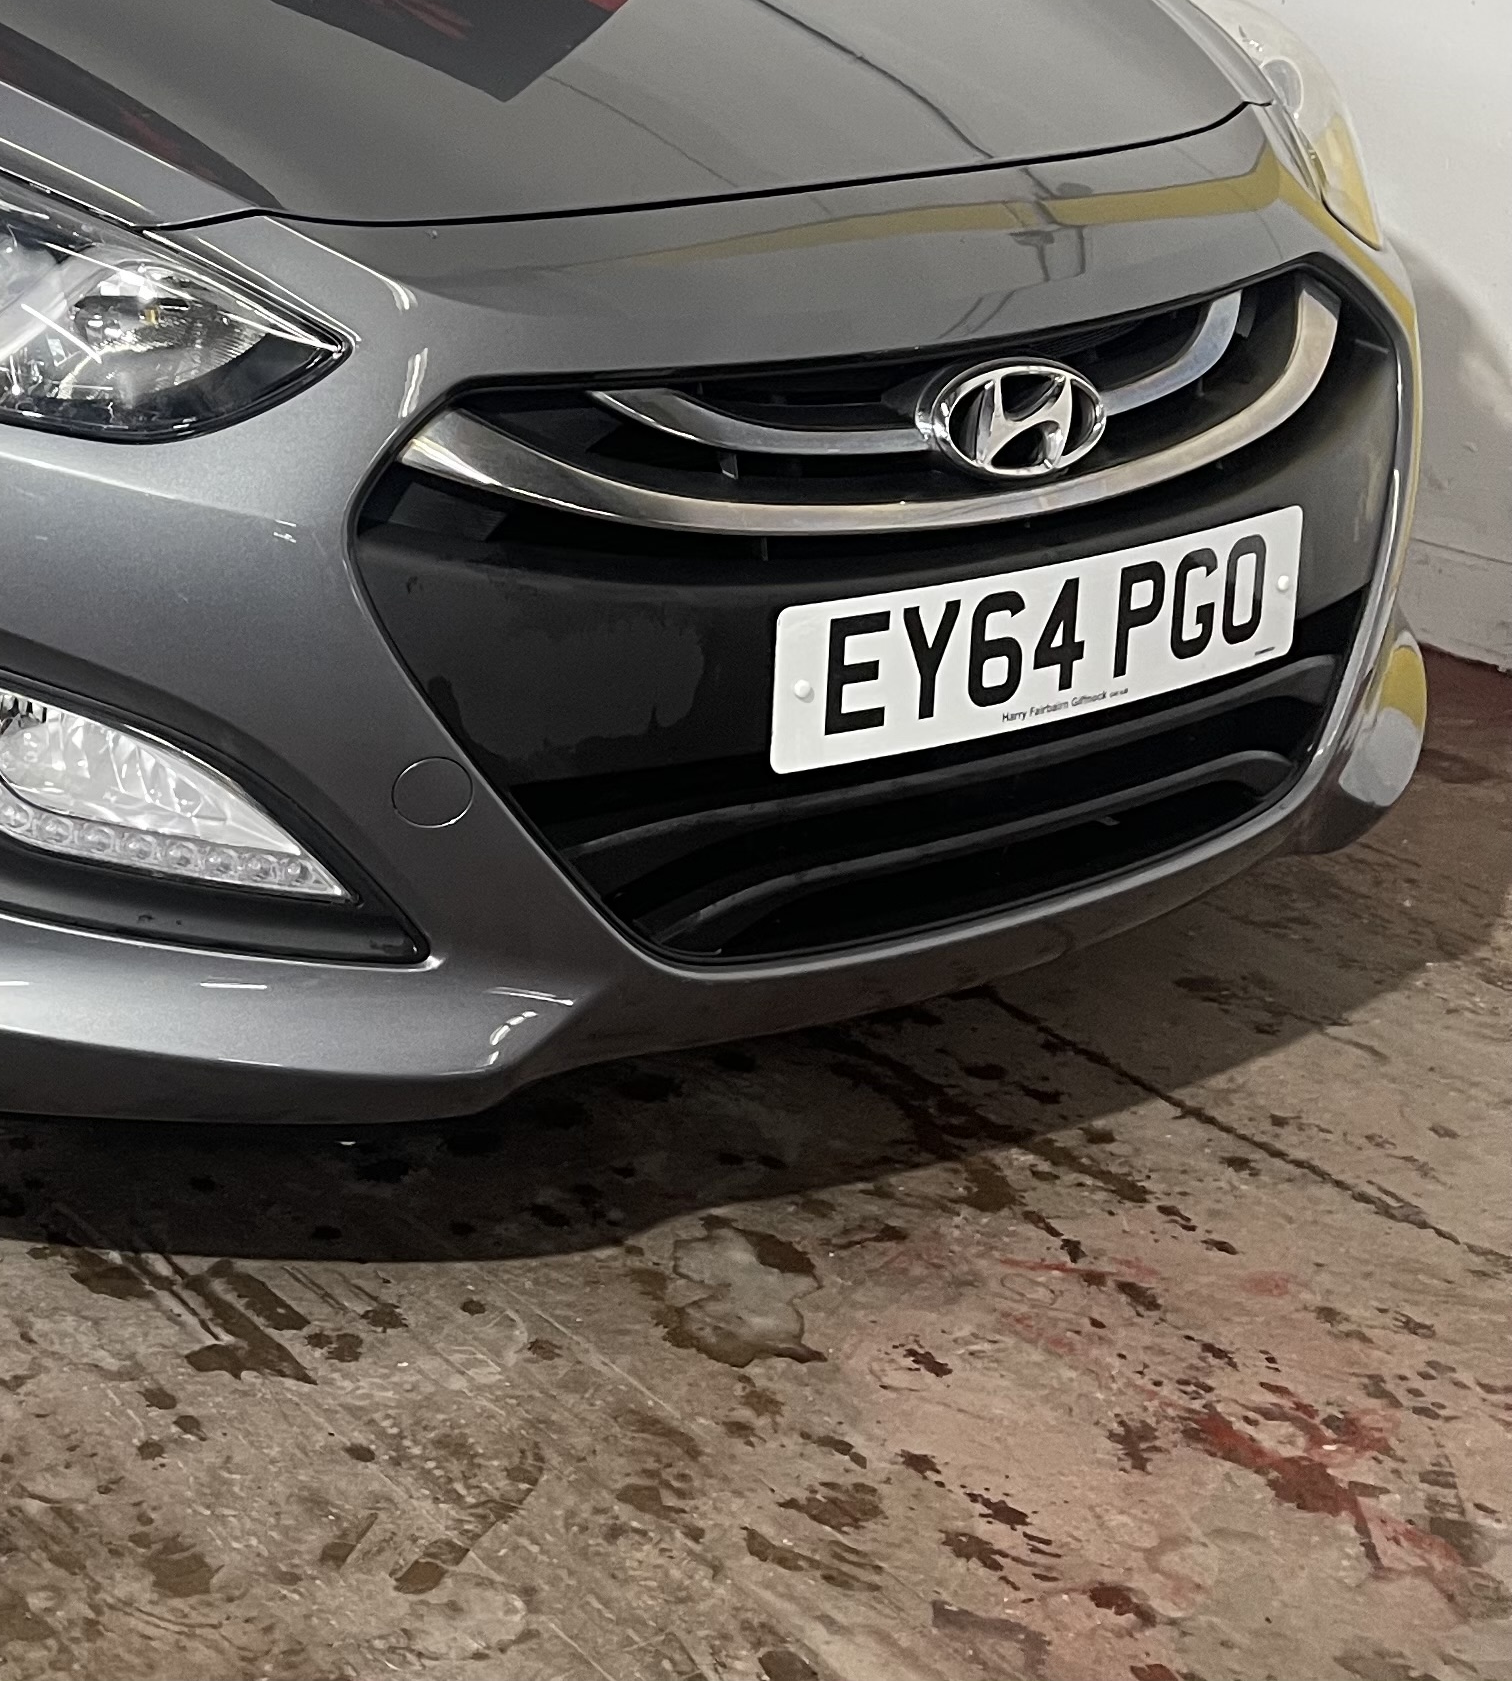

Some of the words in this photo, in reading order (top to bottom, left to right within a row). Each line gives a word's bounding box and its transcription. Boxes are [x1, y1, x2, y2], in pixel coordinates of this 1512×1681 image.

[824, 578, 1085, 736] EY64
[1113, 534, 1267, 679] PGO
[1002, 711, 1026, 722] Harry
